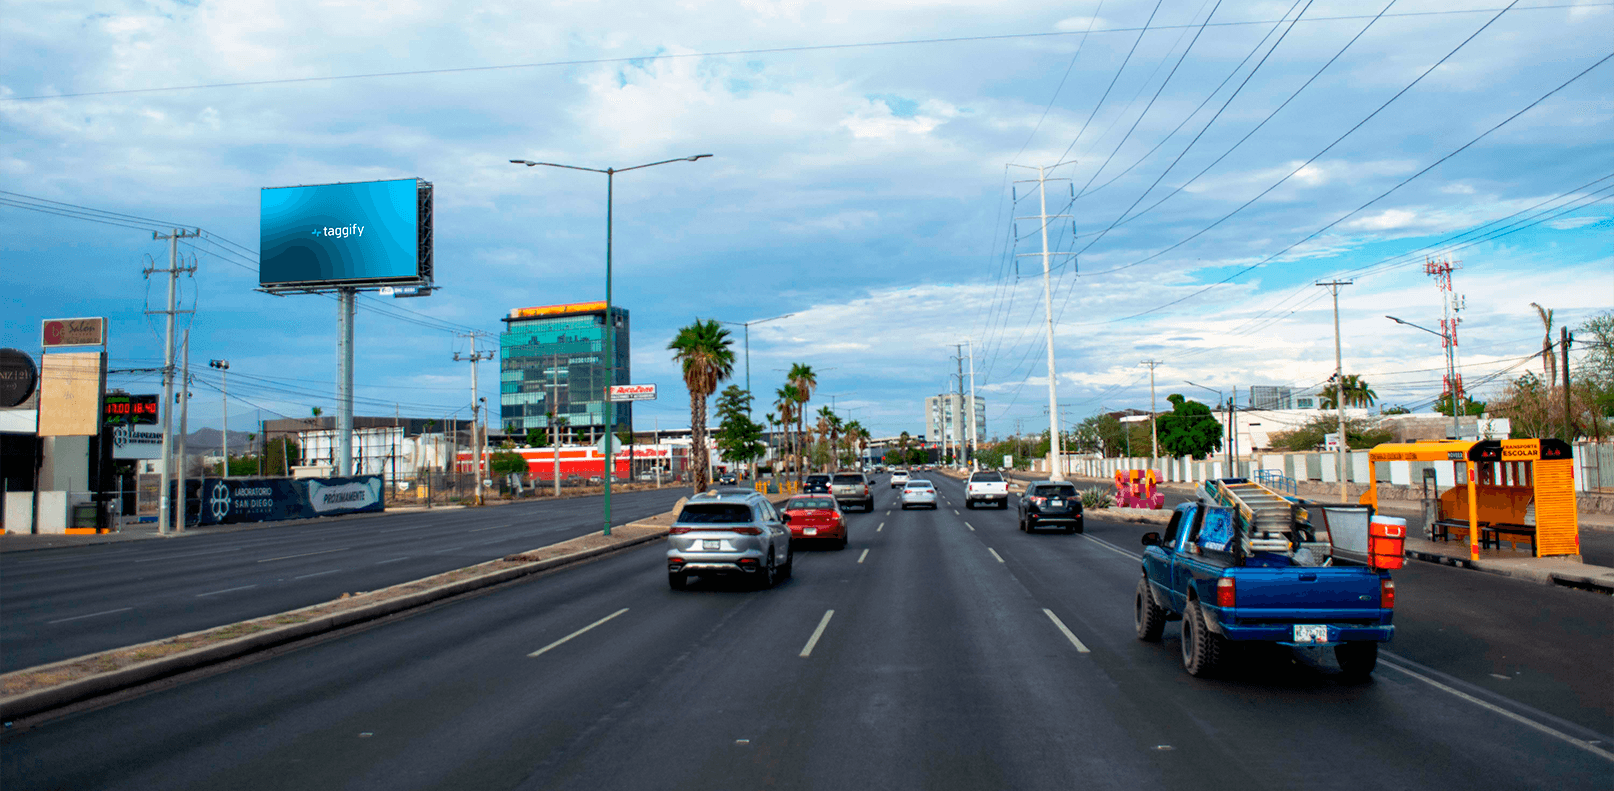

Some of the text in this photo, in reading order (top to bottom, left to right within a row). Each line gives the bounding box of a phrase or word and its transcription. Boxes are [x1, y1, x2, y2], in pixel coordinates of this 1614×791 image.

[323, 224, 364, 238] taggify
[235, 487, 272, 496] LABORATORIO
[323, 490, 366, 504] PRÓXIMAMENTE
[235, 498, 273, 508] SAN DIEGO
